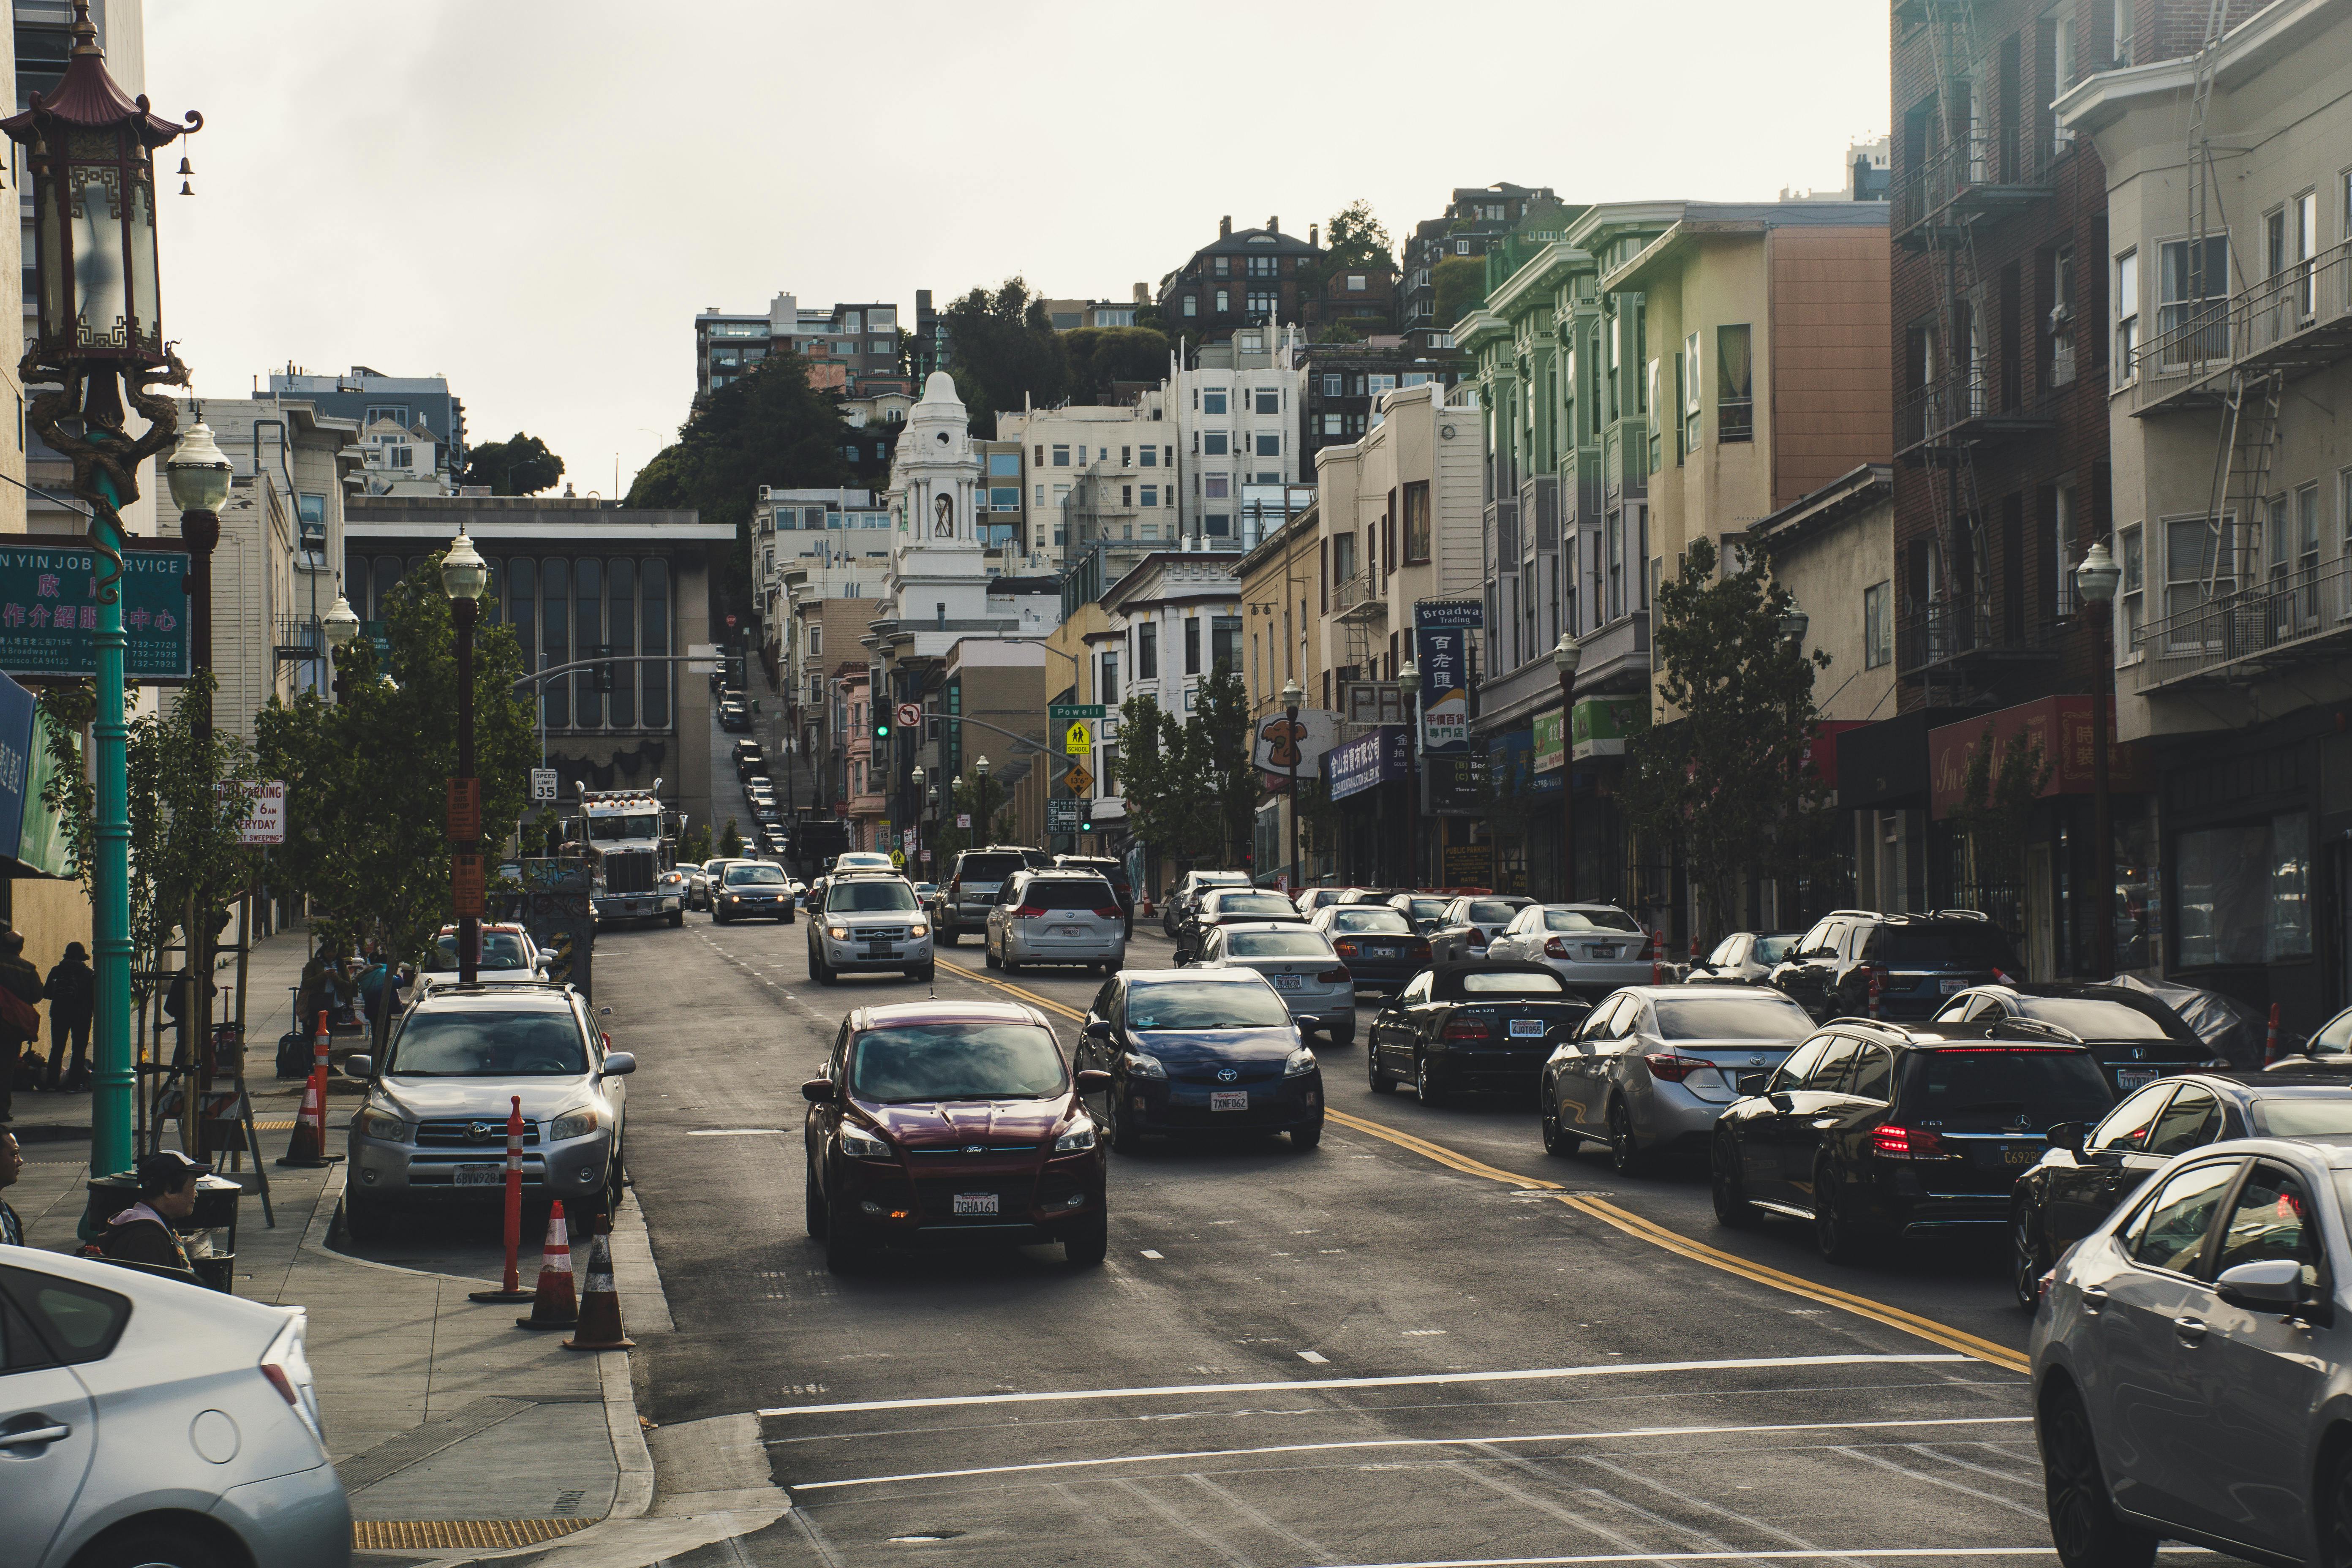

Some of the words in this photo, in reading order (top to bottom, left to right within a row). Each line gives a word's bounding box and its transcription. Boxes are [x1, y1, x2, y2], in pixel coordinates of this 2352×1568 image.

[16, 555, 49, 568] YIN
[55, 556, 91, 570] JOB
[124, 559, 178, 573] RVICE
[132, 641, 177, 649] 732-7728
[8, 648, 48, 656] Broadway
[1430, 636, 1454, 688] 百老匯
[1426, 714, 1465, 725] 平價百貨
[1429, 727, 1463, 738] 專門店
[1331, 736, 1379, 778] 金山拍賣有限公司
[1455, 762, 1468, 770] (B)
[1937, 748, 1956, 792] In
[1455, 773, 1468, 781] (C)
[537, 787, 555, 798] 35
[1467, 845, 1491, 853] PARKING
[1513, 1026, 1541, 1034] 6JQT855
[1213, 1099, 1246, 1108] 7XNF062
[956, 1201, 996, 1213] 7GHA161
